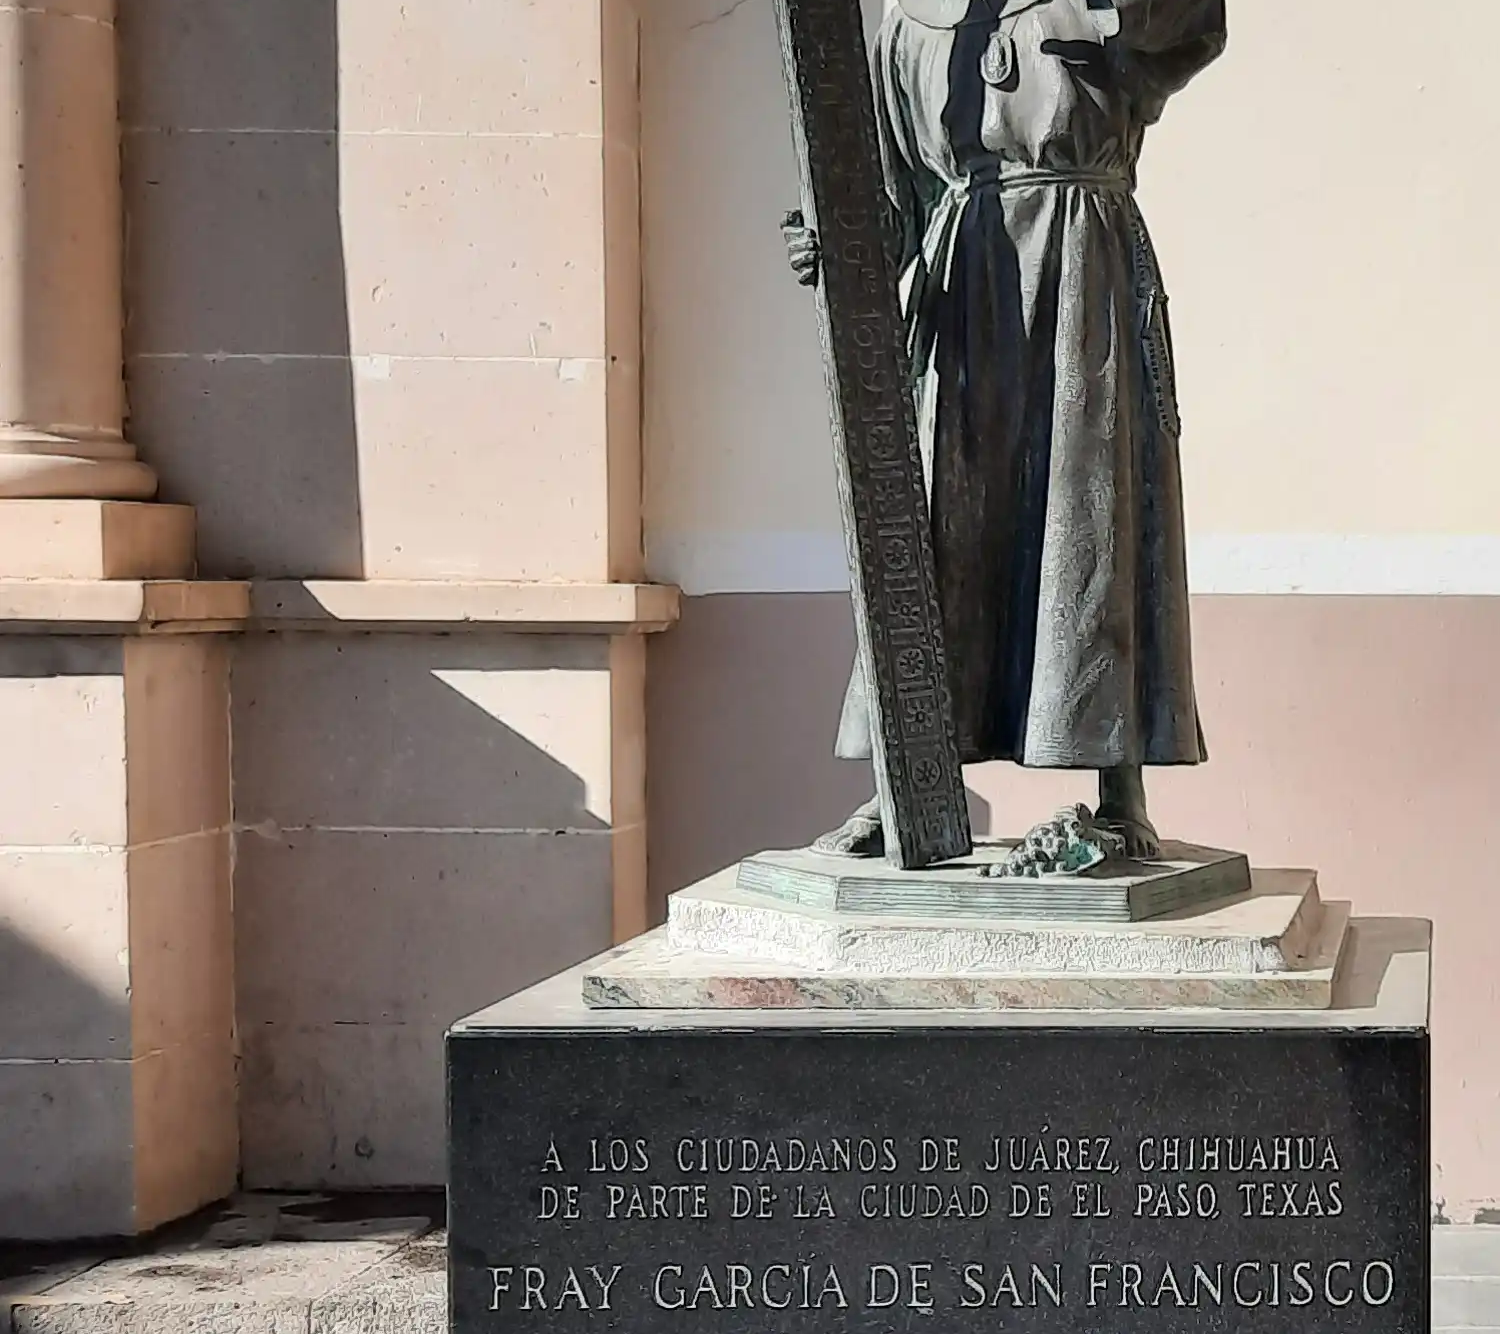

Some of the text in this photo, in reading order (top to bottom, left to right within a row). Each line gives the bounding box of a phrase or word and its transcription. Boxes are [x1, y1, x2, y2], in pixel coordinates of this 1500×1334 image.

[544, 1127, 1340, 1176] A LOS CIUDADANOS DE JUÁREZ, CHIHUAHUA
[537, 1183, 1343, 1222] DE PARTE DE LA CIUDAD DE EL PASO, TEXAS
[487, 1255, 1395, 1310] FRAY GARCÍA DE SAN FRANCISCO
